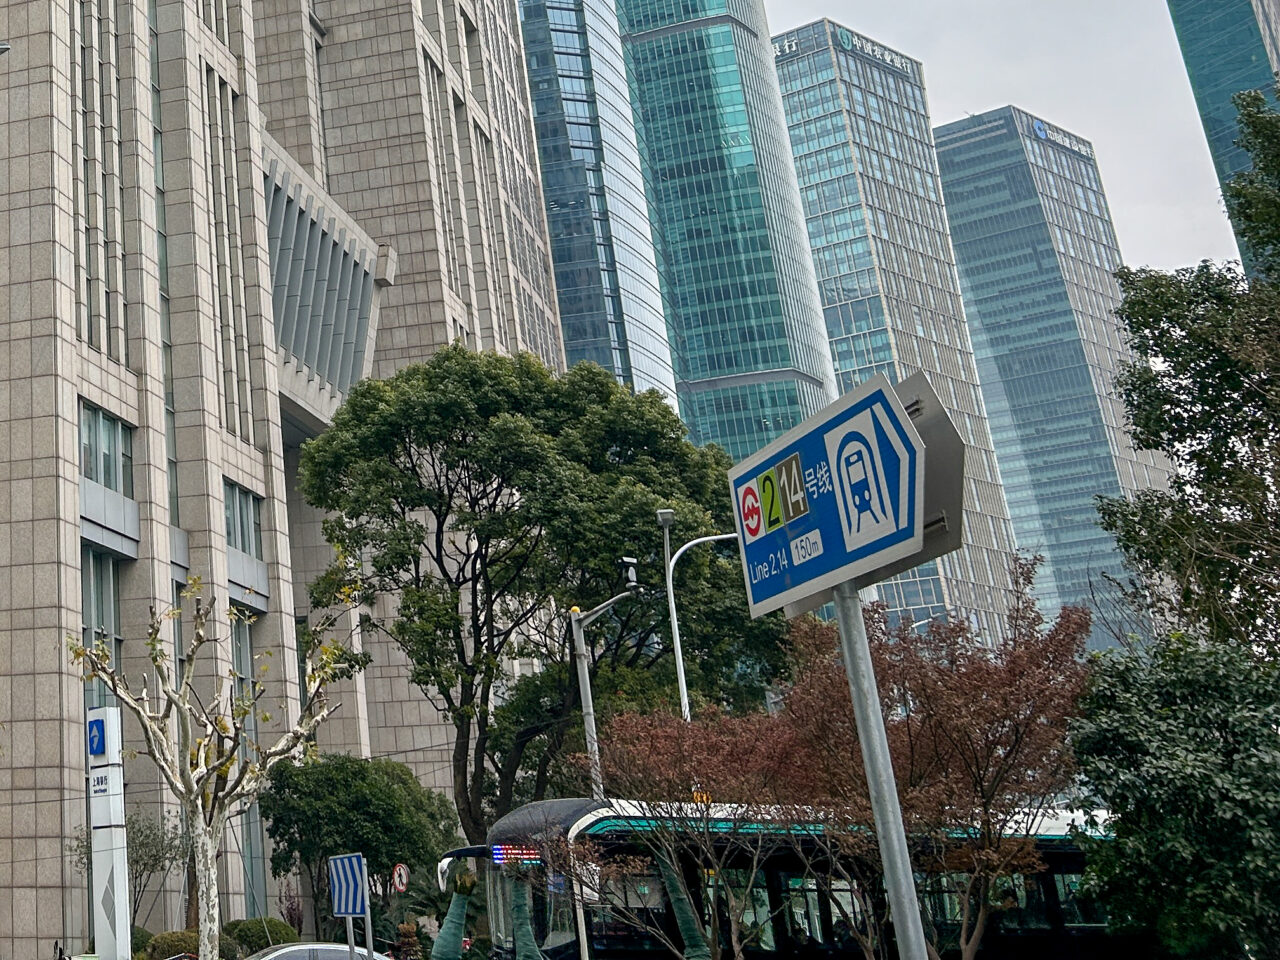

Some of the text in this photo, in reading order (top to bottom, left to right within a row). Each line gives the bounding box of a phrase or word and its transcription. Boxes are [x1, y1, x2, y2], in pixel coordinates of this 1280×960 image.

[852, 35, 911, 73] 中国农业银行
[762, 460, 832, 528] 2 14 号线
[749, 548, 788, 584] Line 2,14
[794, 536, 819, 561] 150m
